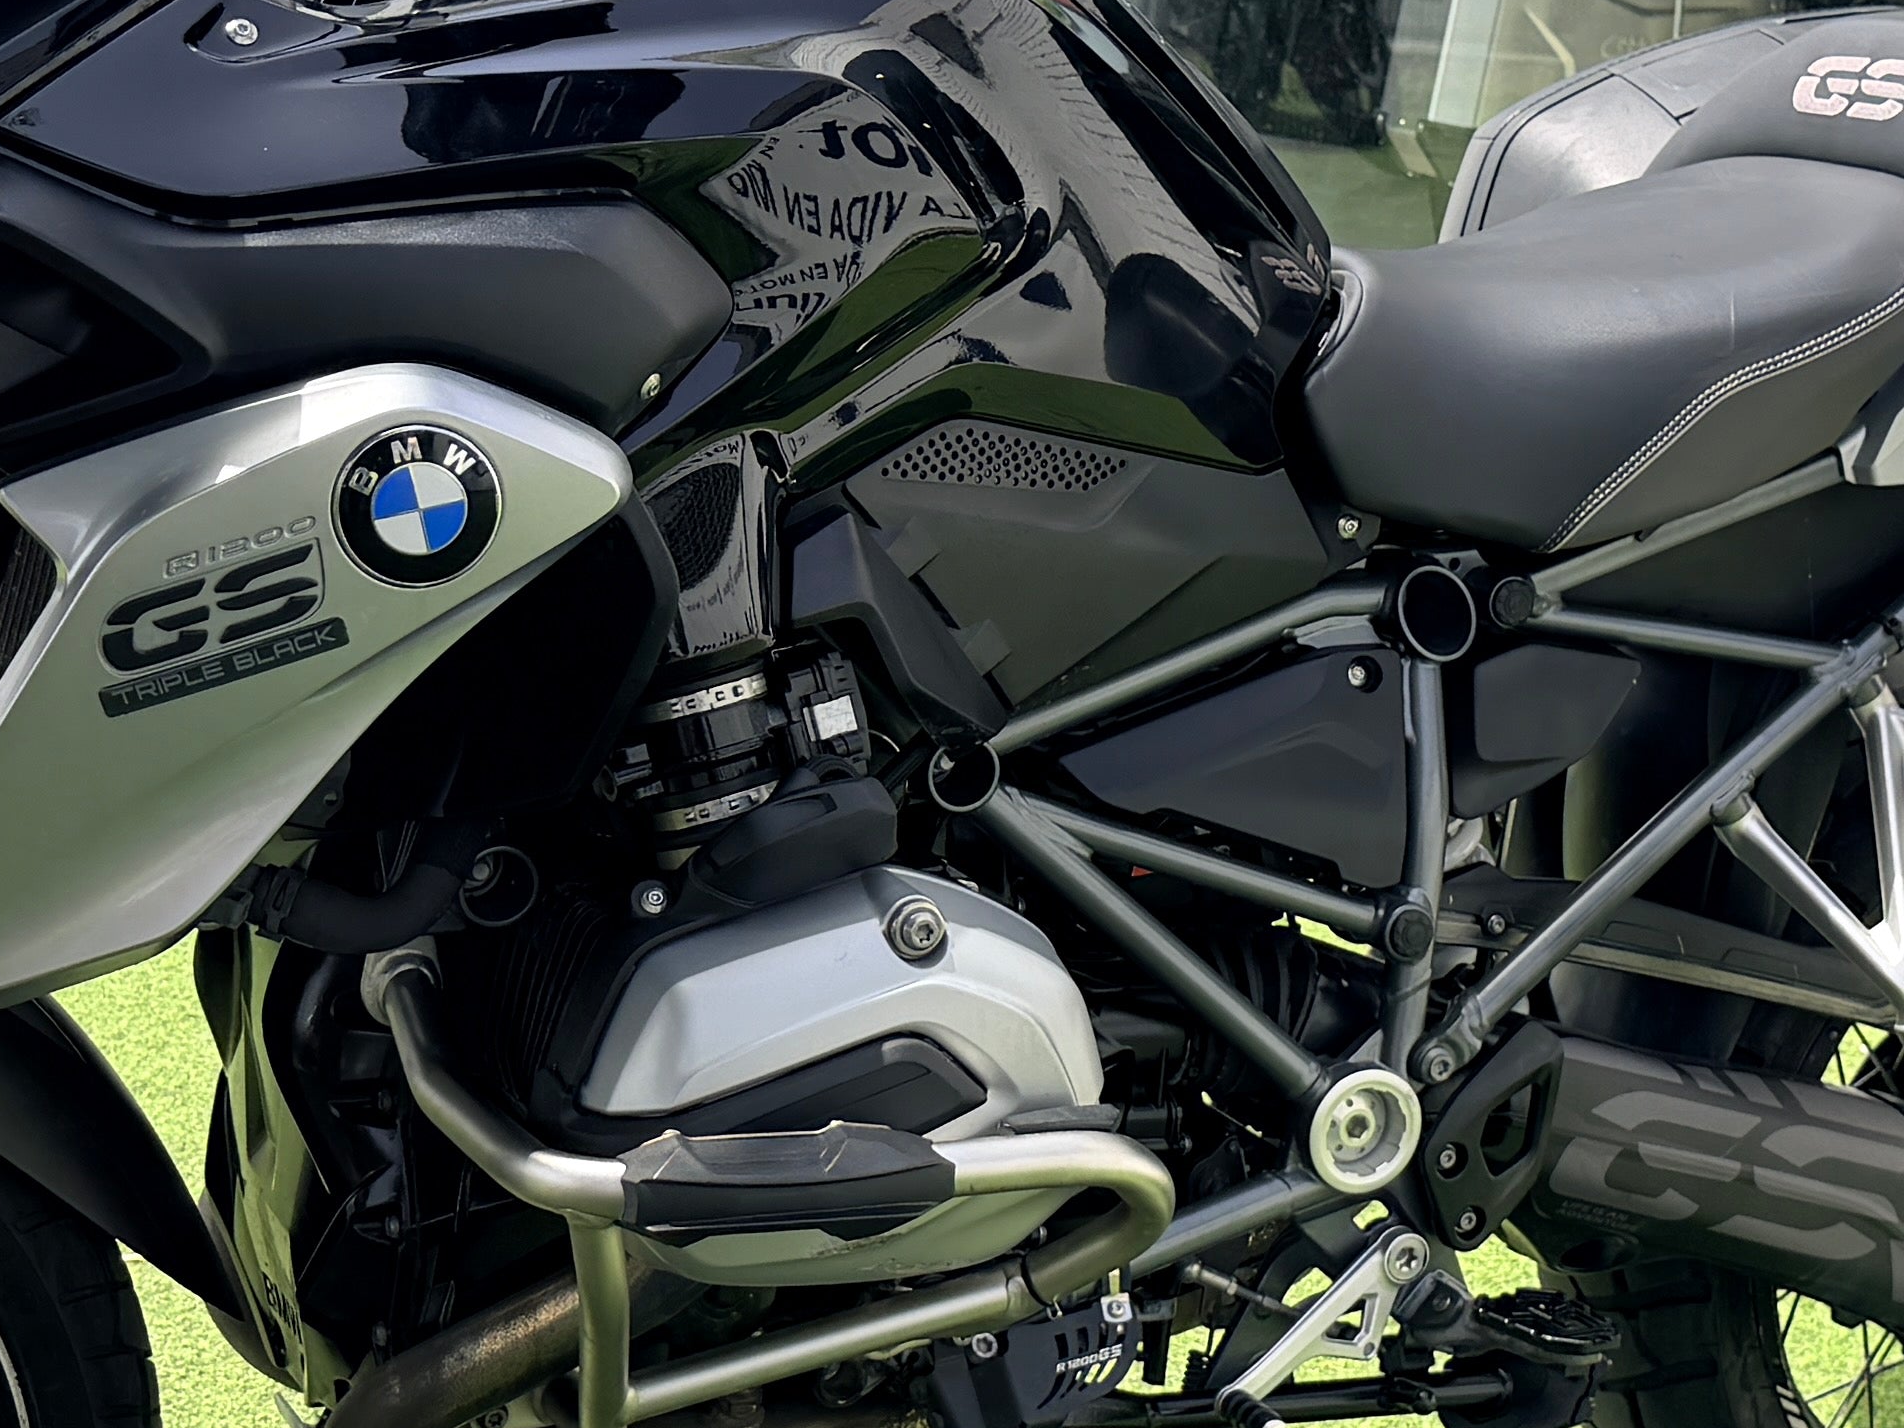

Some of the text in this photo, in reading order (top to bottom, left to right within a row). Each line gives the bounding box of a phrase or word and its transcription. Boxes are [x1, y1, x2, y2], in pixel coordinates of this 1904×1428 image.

[349, 436, 477, 497] BMW
[164, 515, 317, 577] R1200
[102, 543, 319, 671] GS
[111, 625, 337, 706] TRIPLE BLACK
